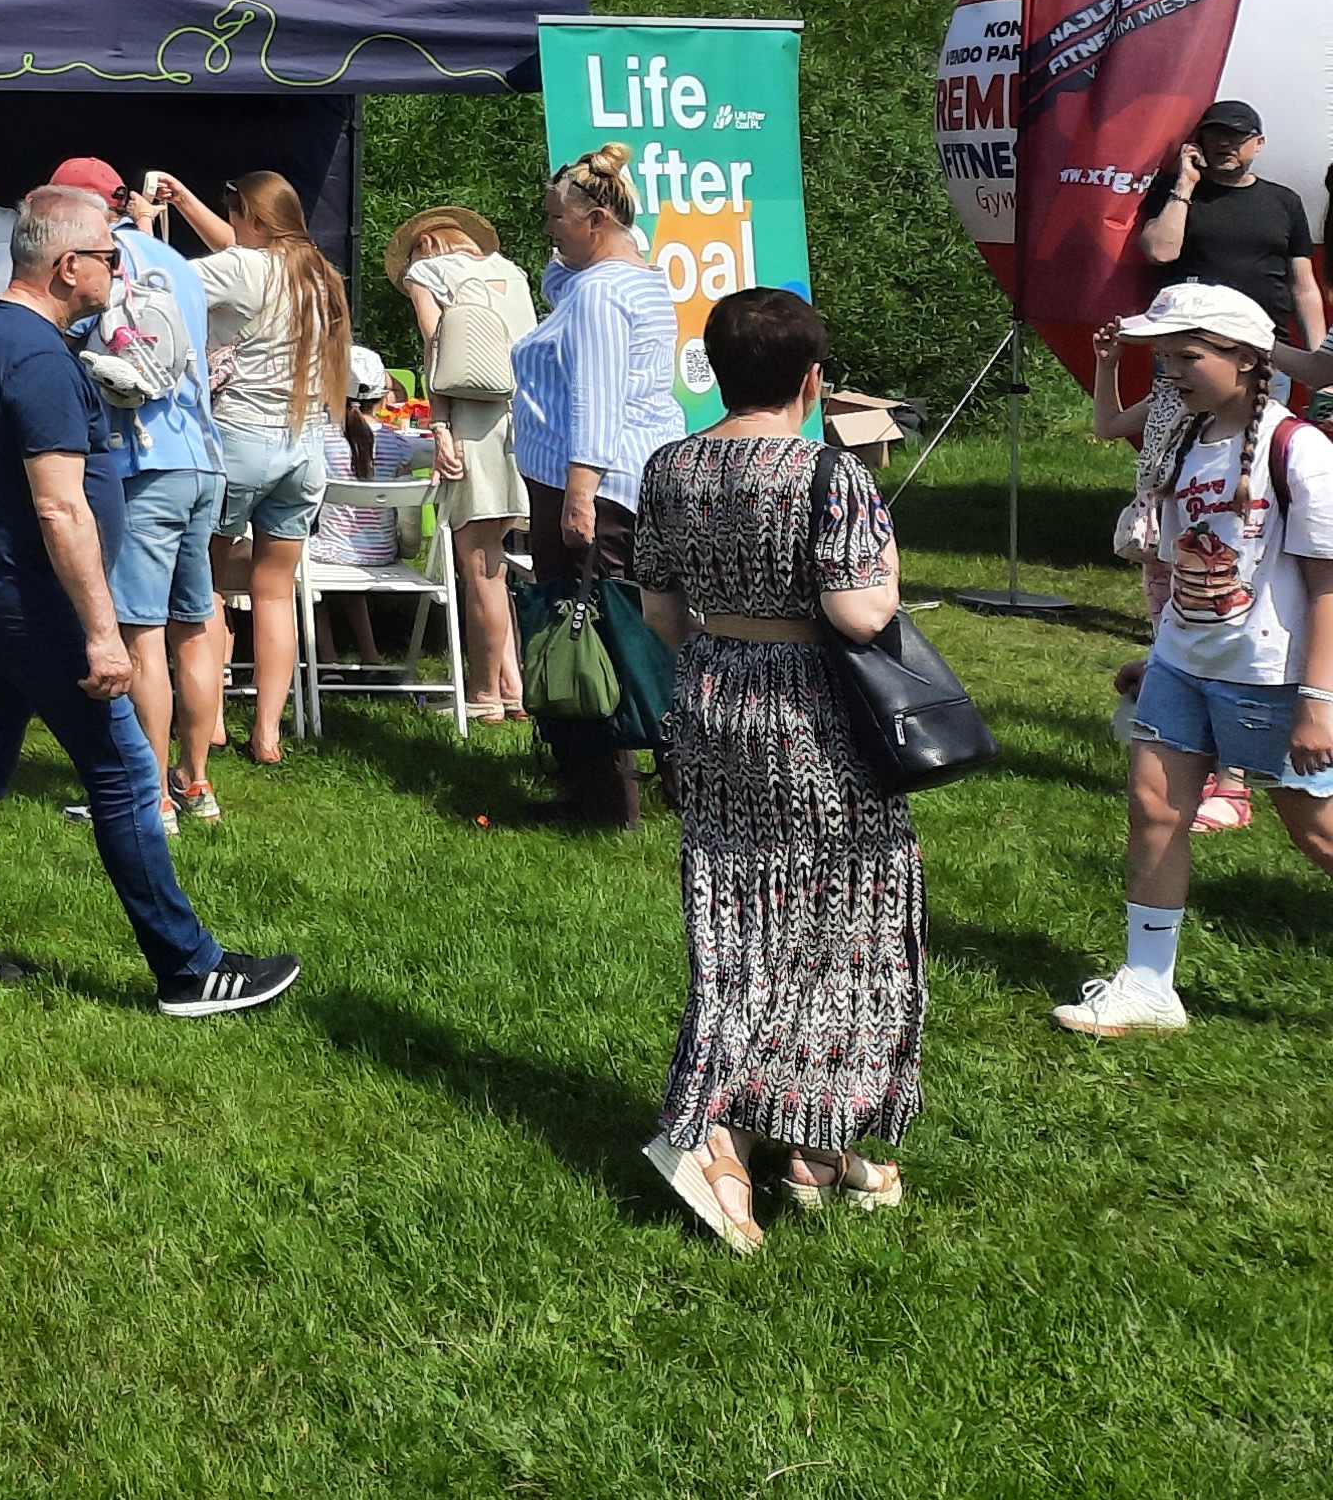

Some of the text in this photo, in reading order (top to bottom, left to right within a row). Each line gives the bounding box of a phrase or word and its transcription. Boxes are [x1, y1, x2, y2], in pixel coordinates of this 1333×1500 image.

[984, 20, 1022, 38] KON
[586, 53, 707, 130] Life
[620, 142, 753, 216] fter
[943, 140, 1017, 180] FITNE
[635, 219, 758, 304] oal
